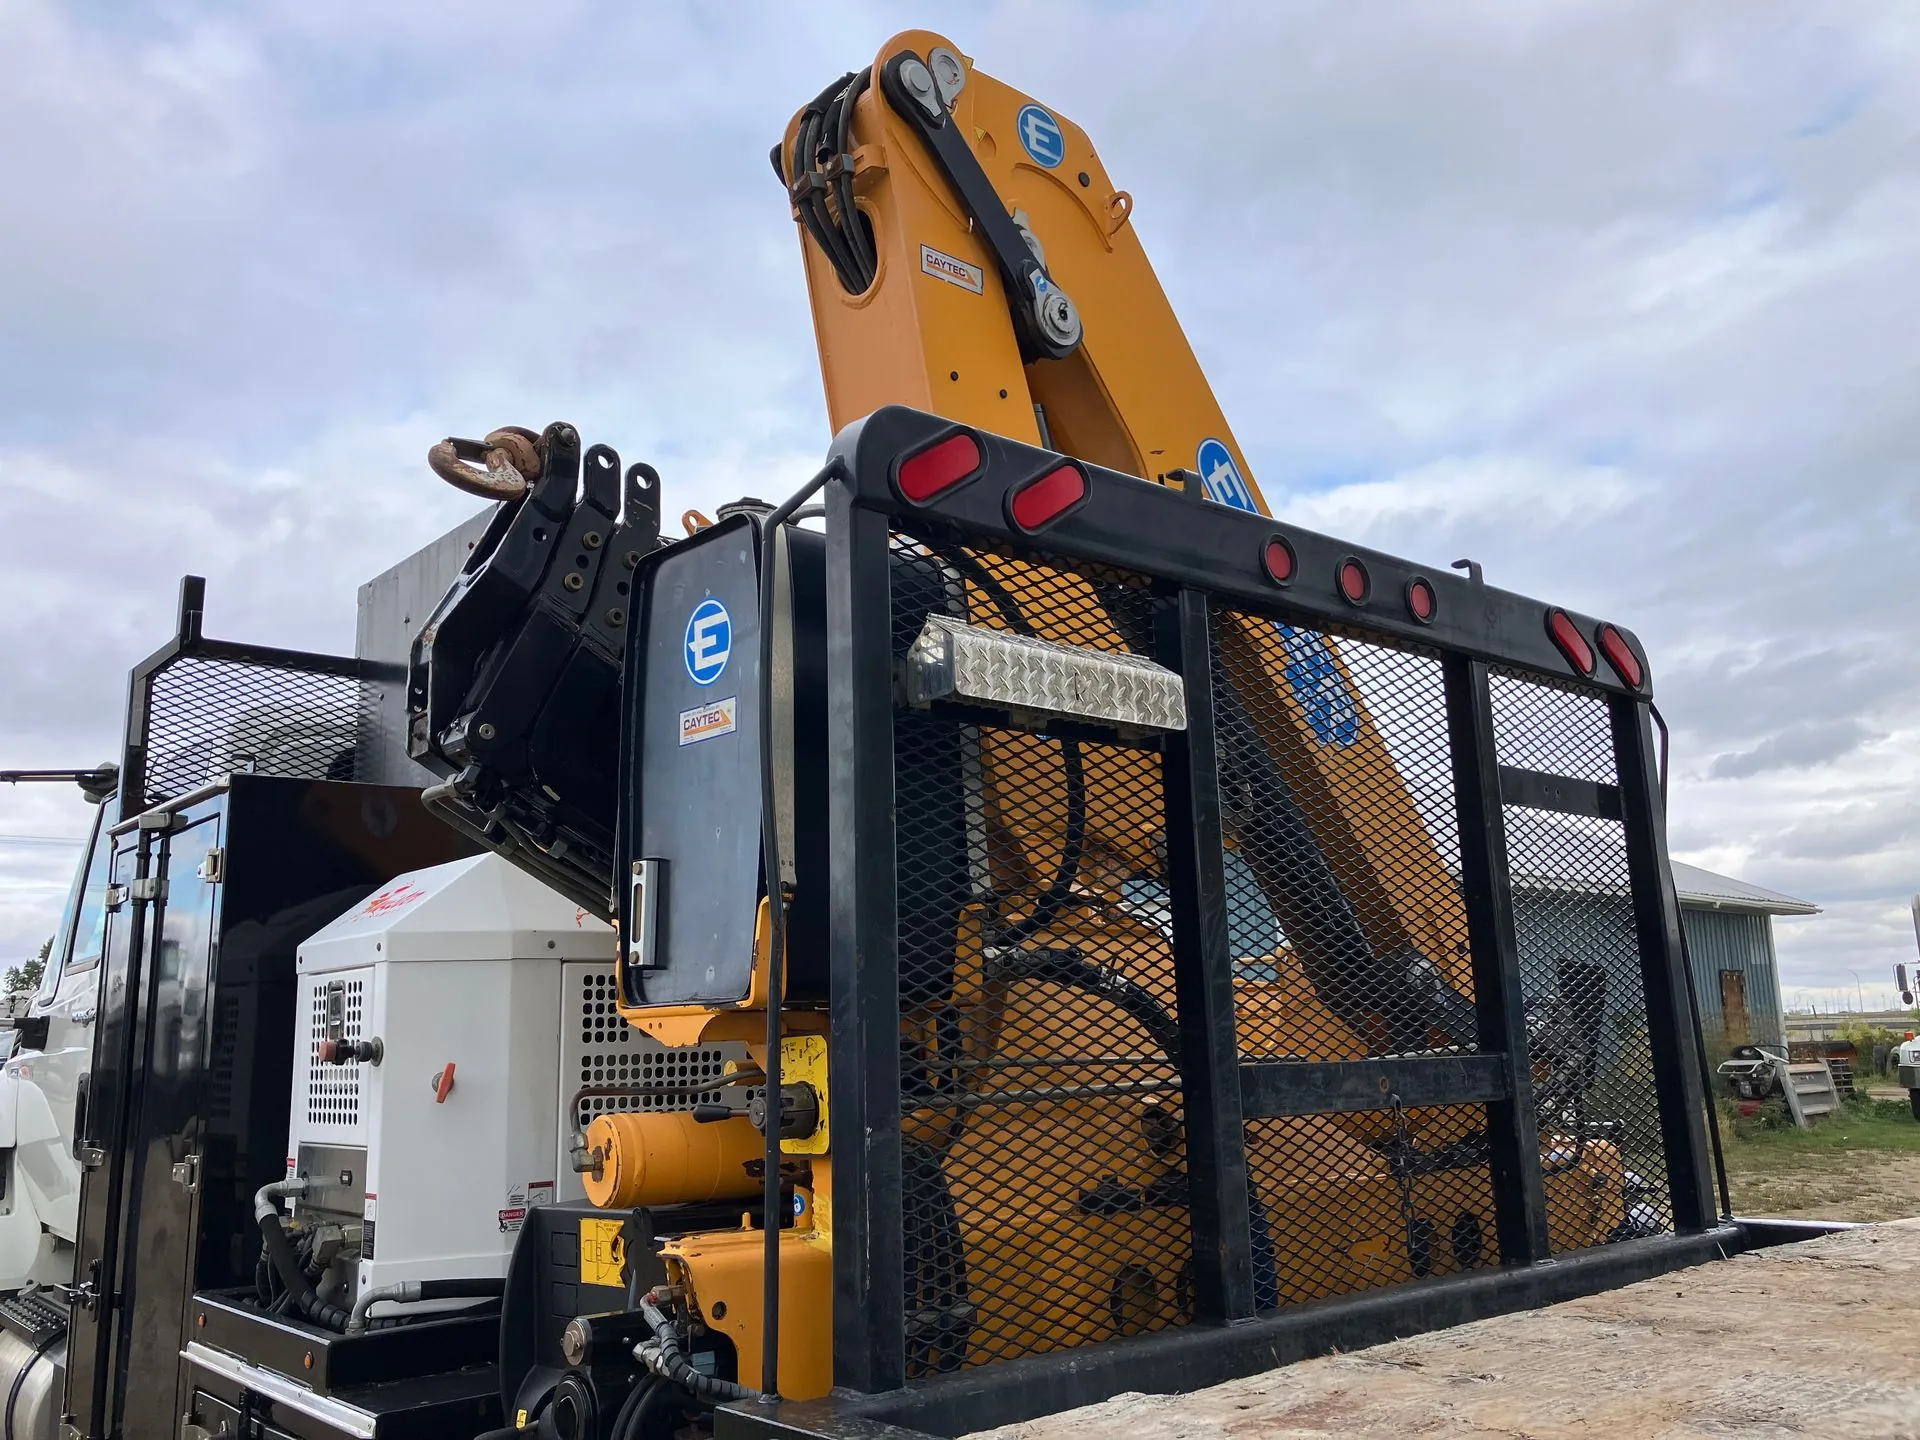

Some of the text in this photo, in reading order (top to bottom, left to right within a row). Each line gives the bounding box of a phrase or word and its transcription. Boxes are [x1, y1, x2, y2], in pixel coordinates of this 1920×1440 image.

[1022, 113, 1061, 162] E
[926, 254, 966, 277] CAYTEC
[687, 610, 729, 671] E
[683, 710, 721, 731] CAYTEC
[501, 1211, 525, 1219] DANGER
